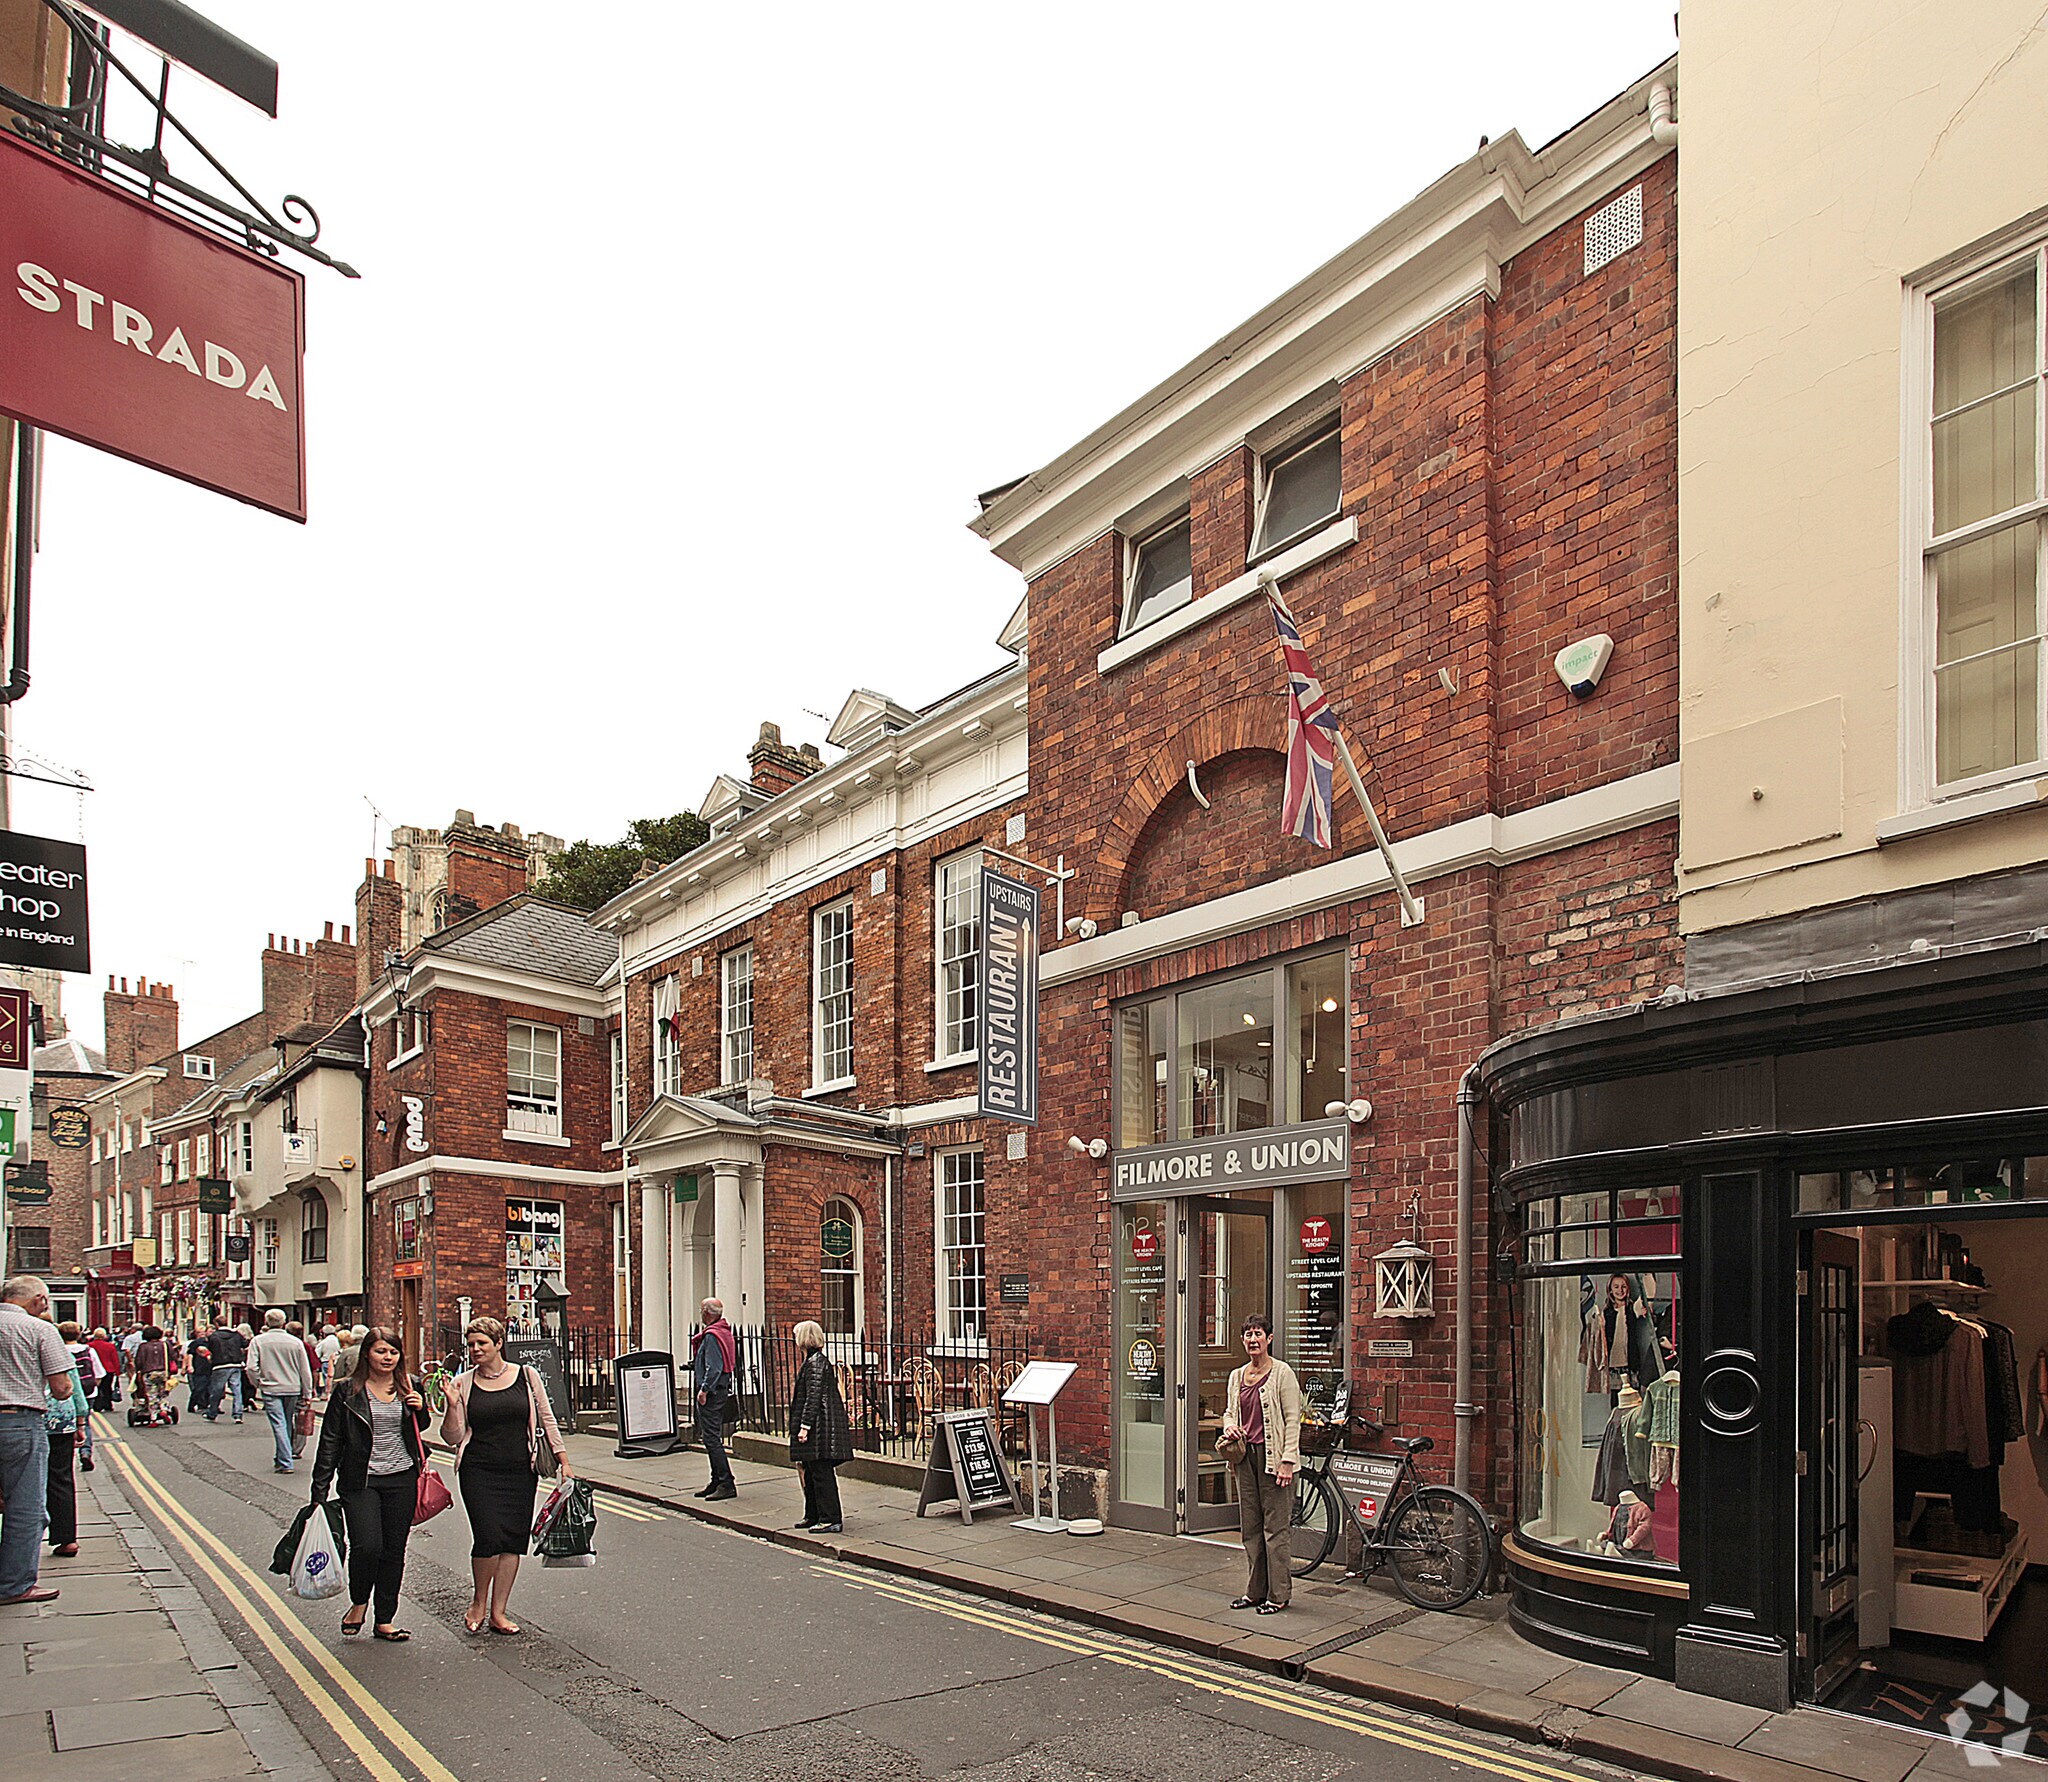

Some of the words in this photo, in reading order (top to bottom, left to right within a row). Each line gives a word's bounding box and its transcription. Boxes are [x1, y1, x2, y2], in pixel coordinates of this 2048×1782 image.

[16, 261, 289, 413] STRADA
[989, 881, 1032, 913] UPSTAIRS
[20, 928, 75, 946] England
[987, 902, 1019, 1110] RESTAURANT
[1117, 1153, 1213, 1187] FILMORE
[1223, 1149, 1243, 1175] &
[1251, 1135, 1344, 1171] UNION
[7, 1184, 47, 1195] Barbour
[1306, 1383, 1324, 1391] taste
[1334, 1461, 1362, 1470] FILMORE
[1370, 1466, 1394, 1476] UNION
